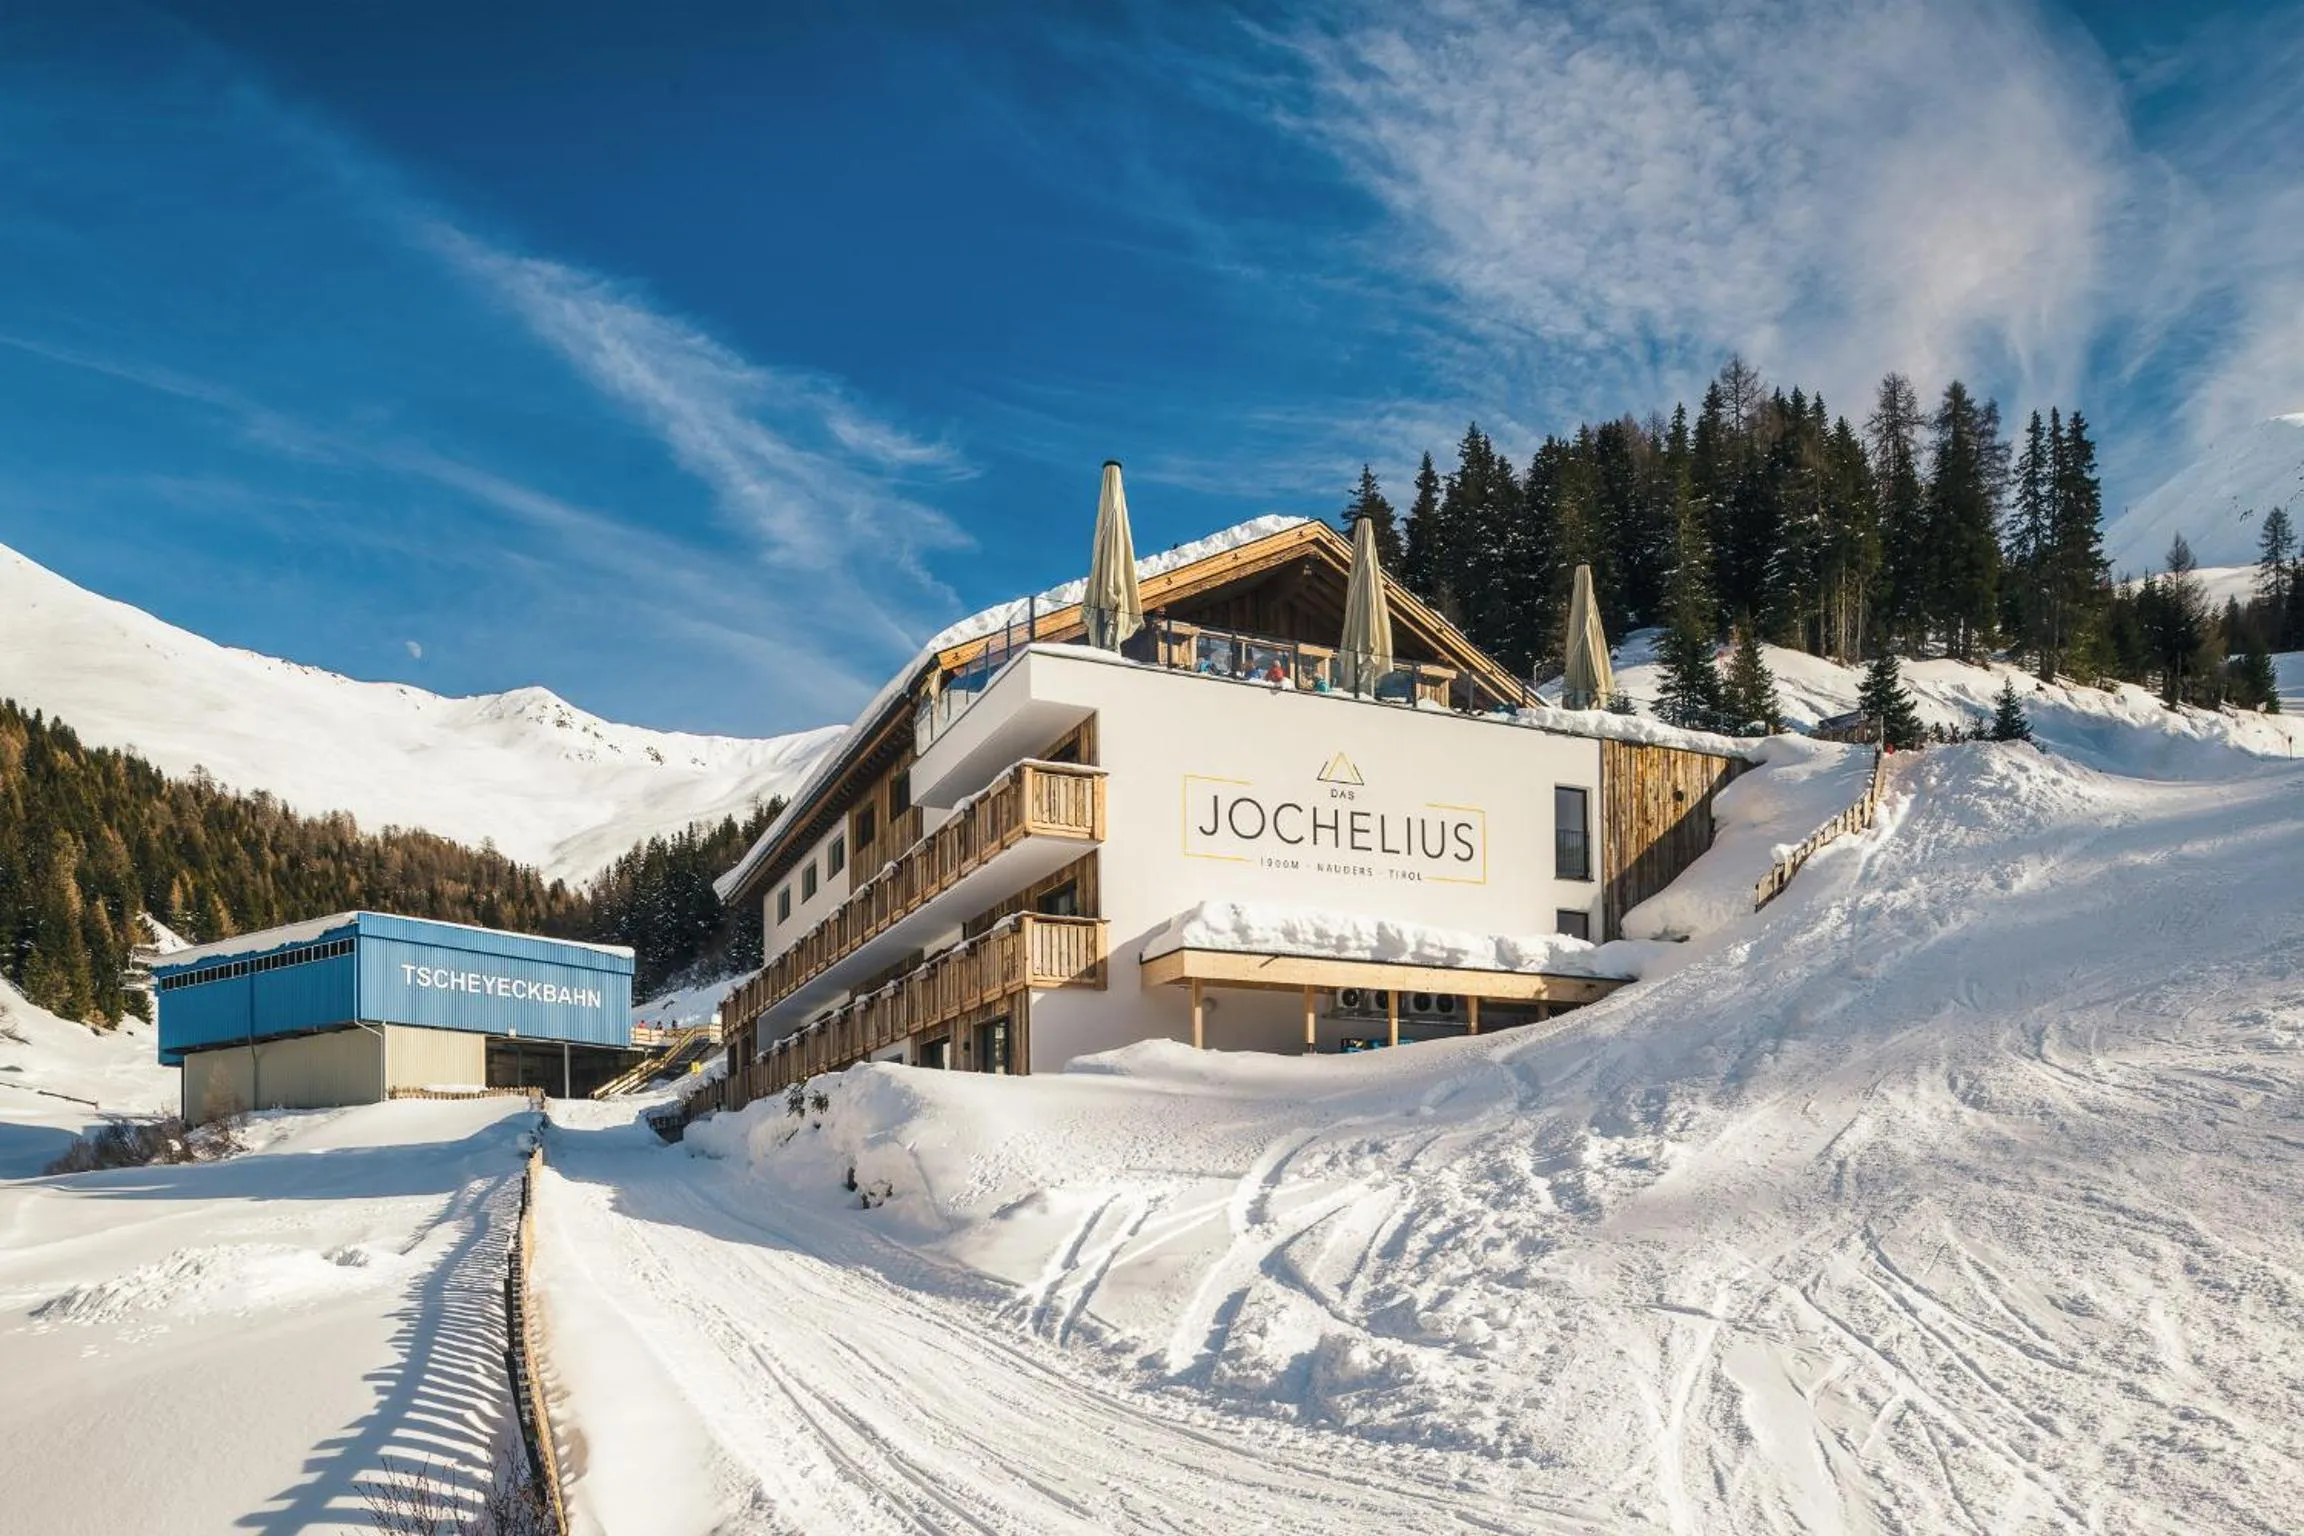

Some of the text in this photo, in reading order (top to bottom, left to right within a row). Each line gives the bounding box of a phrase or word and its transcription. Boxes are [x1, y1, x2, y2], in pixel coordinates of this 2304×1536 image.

[1330, 788, 1355, 800] DAS
[1198, 795, 1474, 862] JOCHELIUS
[1317, 863, 1373, 876] NAUDERS
[1388, 869, 1422, 881] TIROL
[401, 963, 601, 1009] TSCHEYECKBAHN
